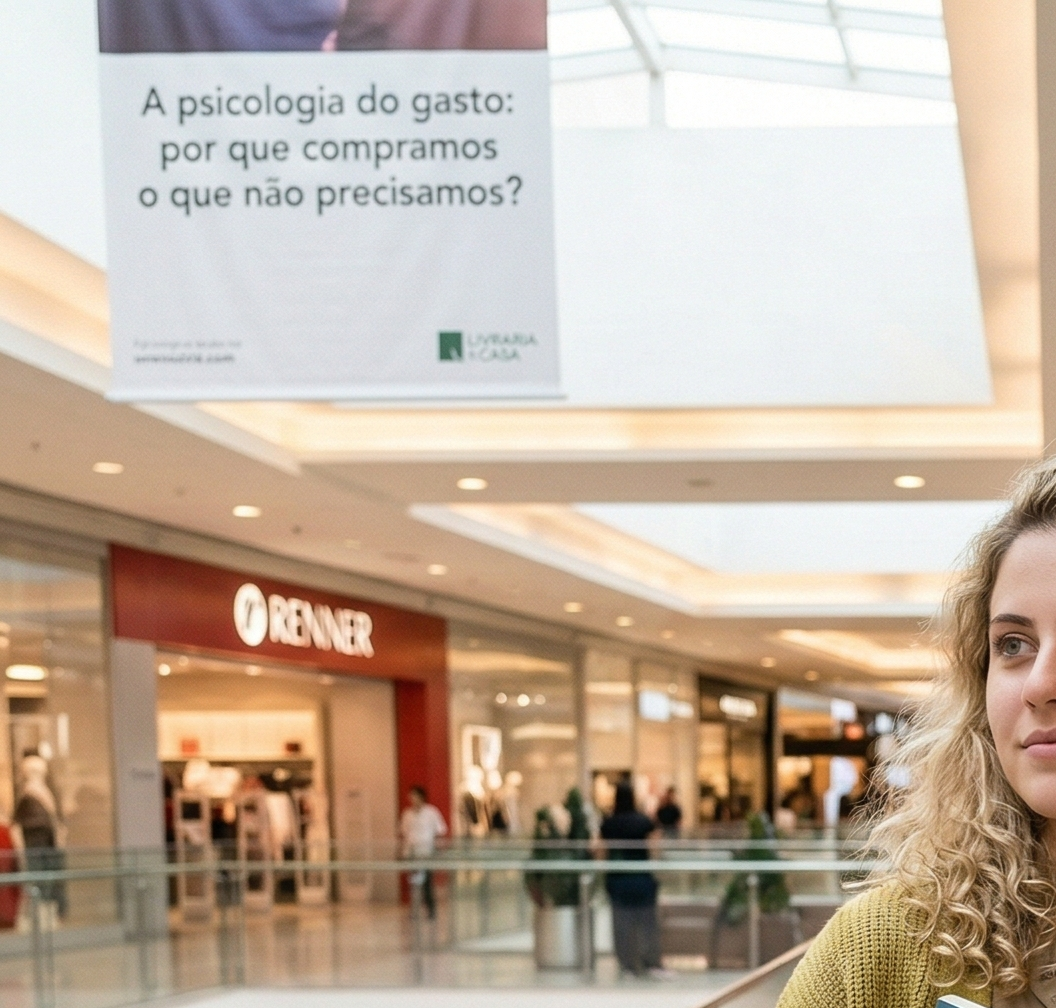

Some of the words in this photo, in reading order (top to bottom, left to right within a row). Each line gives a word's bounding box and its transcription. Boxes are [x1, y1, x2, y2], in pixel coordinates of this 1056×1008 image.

[142, 86, 166, 116] A
[178, 84, 344, 124] psicologia
[357, 83, 400, 115] do
[411, 88, 513, 123] gasto:
[161, 140, 217, 170] por
[228, 139, 290, 169] que
[302, 138, 498, 170] compramos
[138, 186, 158, 208] o
[170, 186, 232, 216] que
[244, 177, 304, 207] não
[317, 175, 523, 216] precisamos?
[268, 594, 375, 659] RENNER
